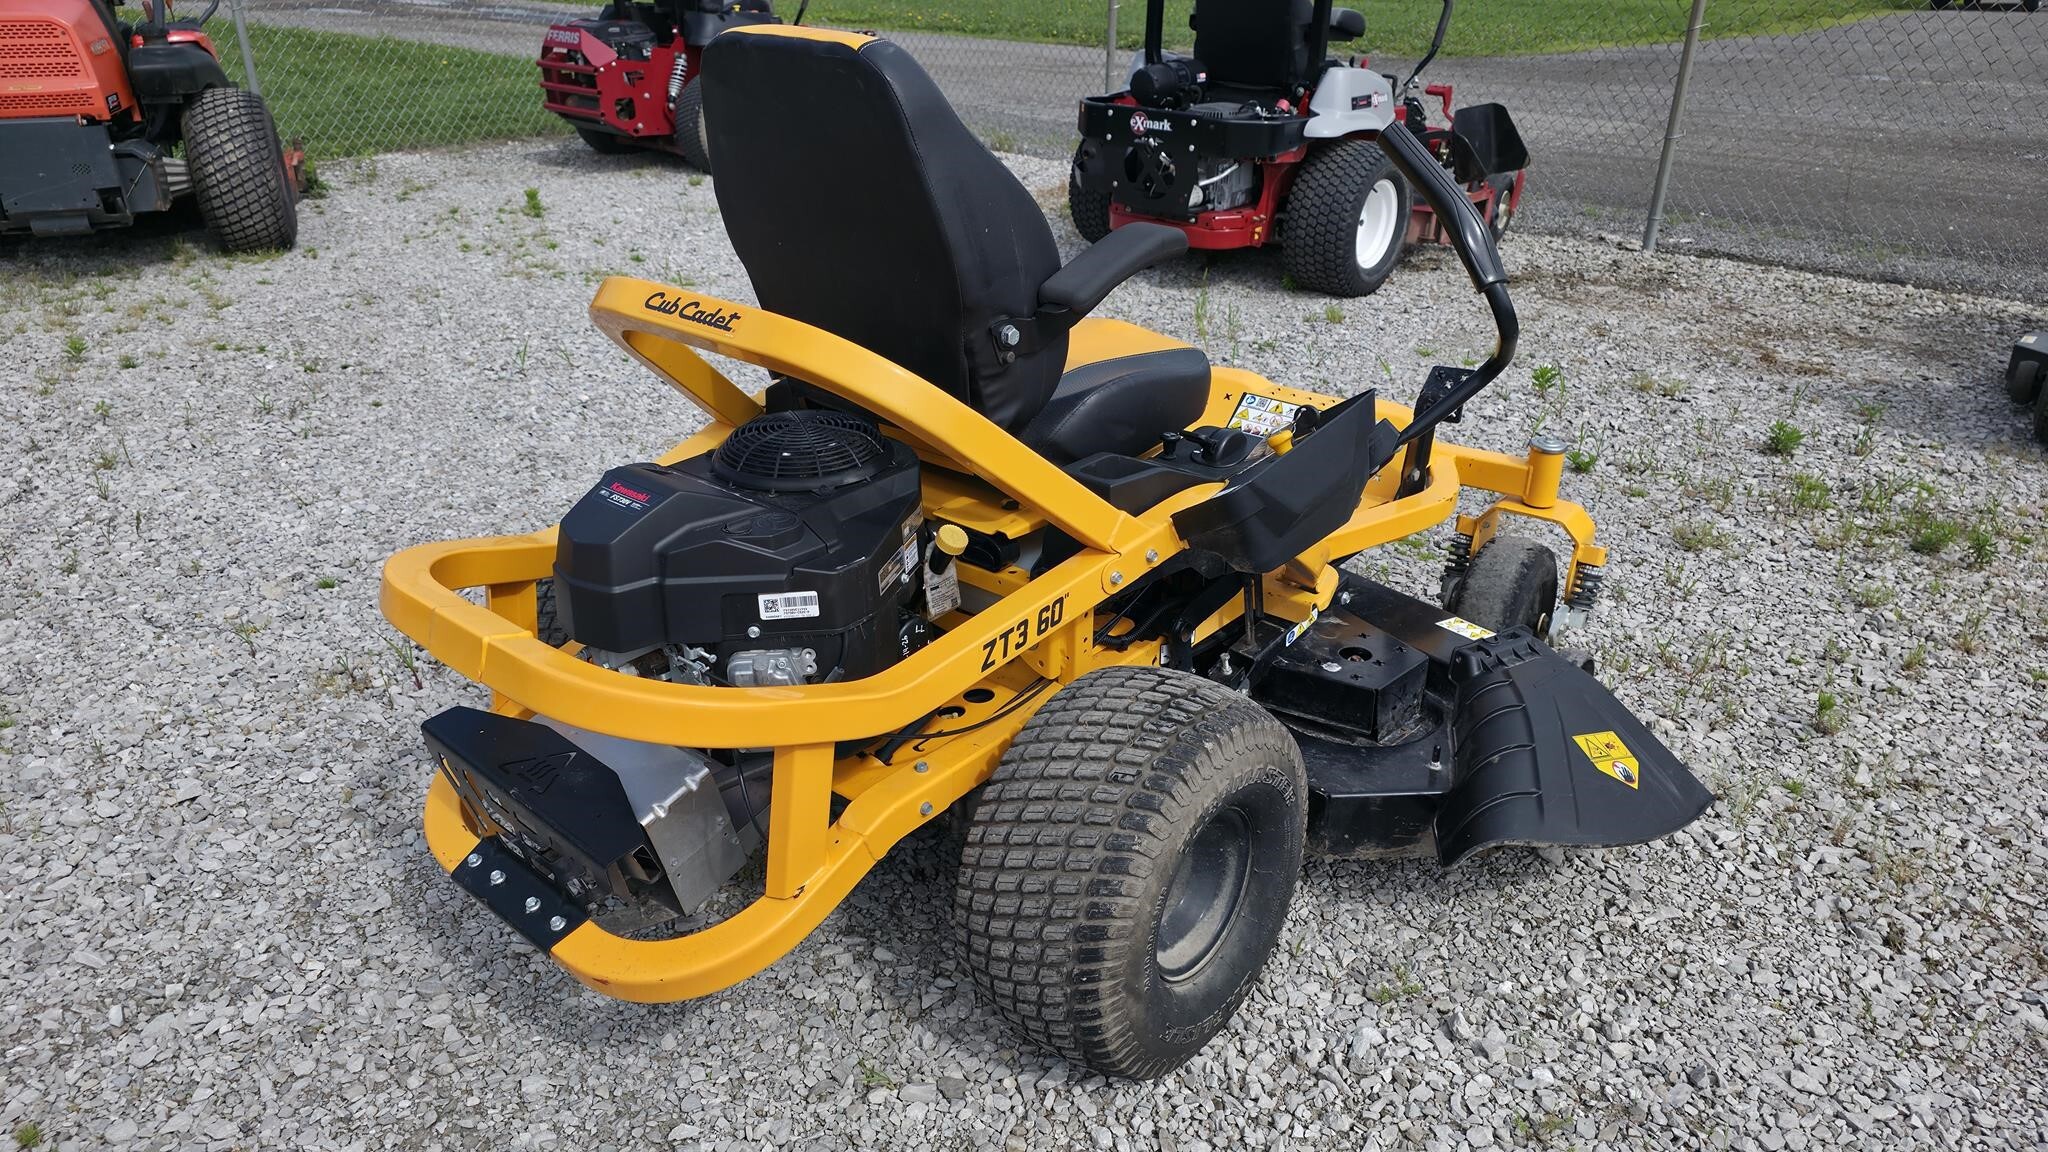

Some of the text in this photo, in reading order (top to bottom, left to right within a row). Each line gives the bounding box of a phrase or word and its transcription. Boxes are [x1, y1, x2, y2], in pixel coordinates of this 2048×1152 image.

[547, 30, 580, 44] FERRIS
[644, 291, 742, 332] Cub Cadet
[610, 481, 651, 502] Kawasaki
[981, 592, 1070, 673] ZT3 60"
